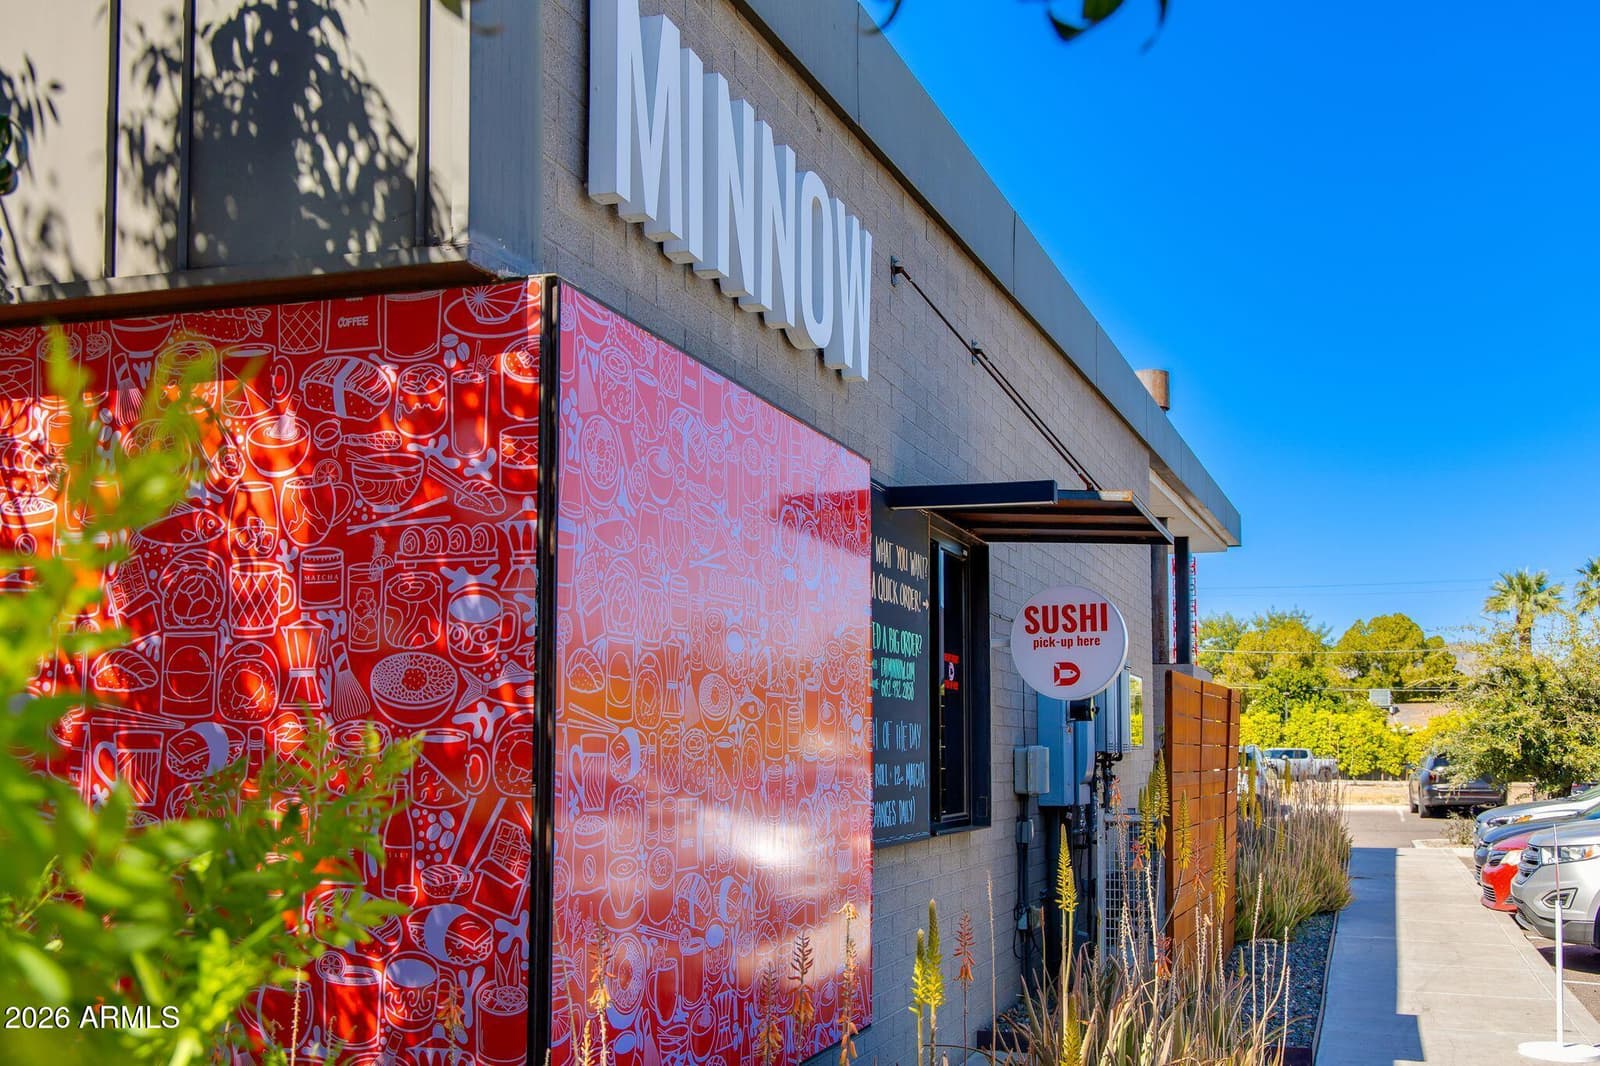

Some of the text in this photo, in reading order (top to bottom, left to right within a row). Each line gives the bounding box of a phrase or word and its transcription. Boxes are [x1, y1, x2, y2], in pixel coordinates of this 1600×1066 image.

[588, 0, 873, 382] MINNOW
[337, 315, 369, 328] COFFEE
[875, 535, 893, 568] WHAT
[896, 545, 908, 571] YOU
[878, 573, 899, 604] QUICK
[1024, 602, 1108, 634] SUSHI
[882, 625, 888, 654] A
[889, 627, 900, 654] BIG
[901, 630, 923, 658] ORDER?
[1033, 635, 1101, 650] pick-up here
[882, 720, 894, 751] OF
[896, 719, 908, 752] THE
[908, 722, 922, 751] DAY
[875, 763, 888, 789] ROLL
